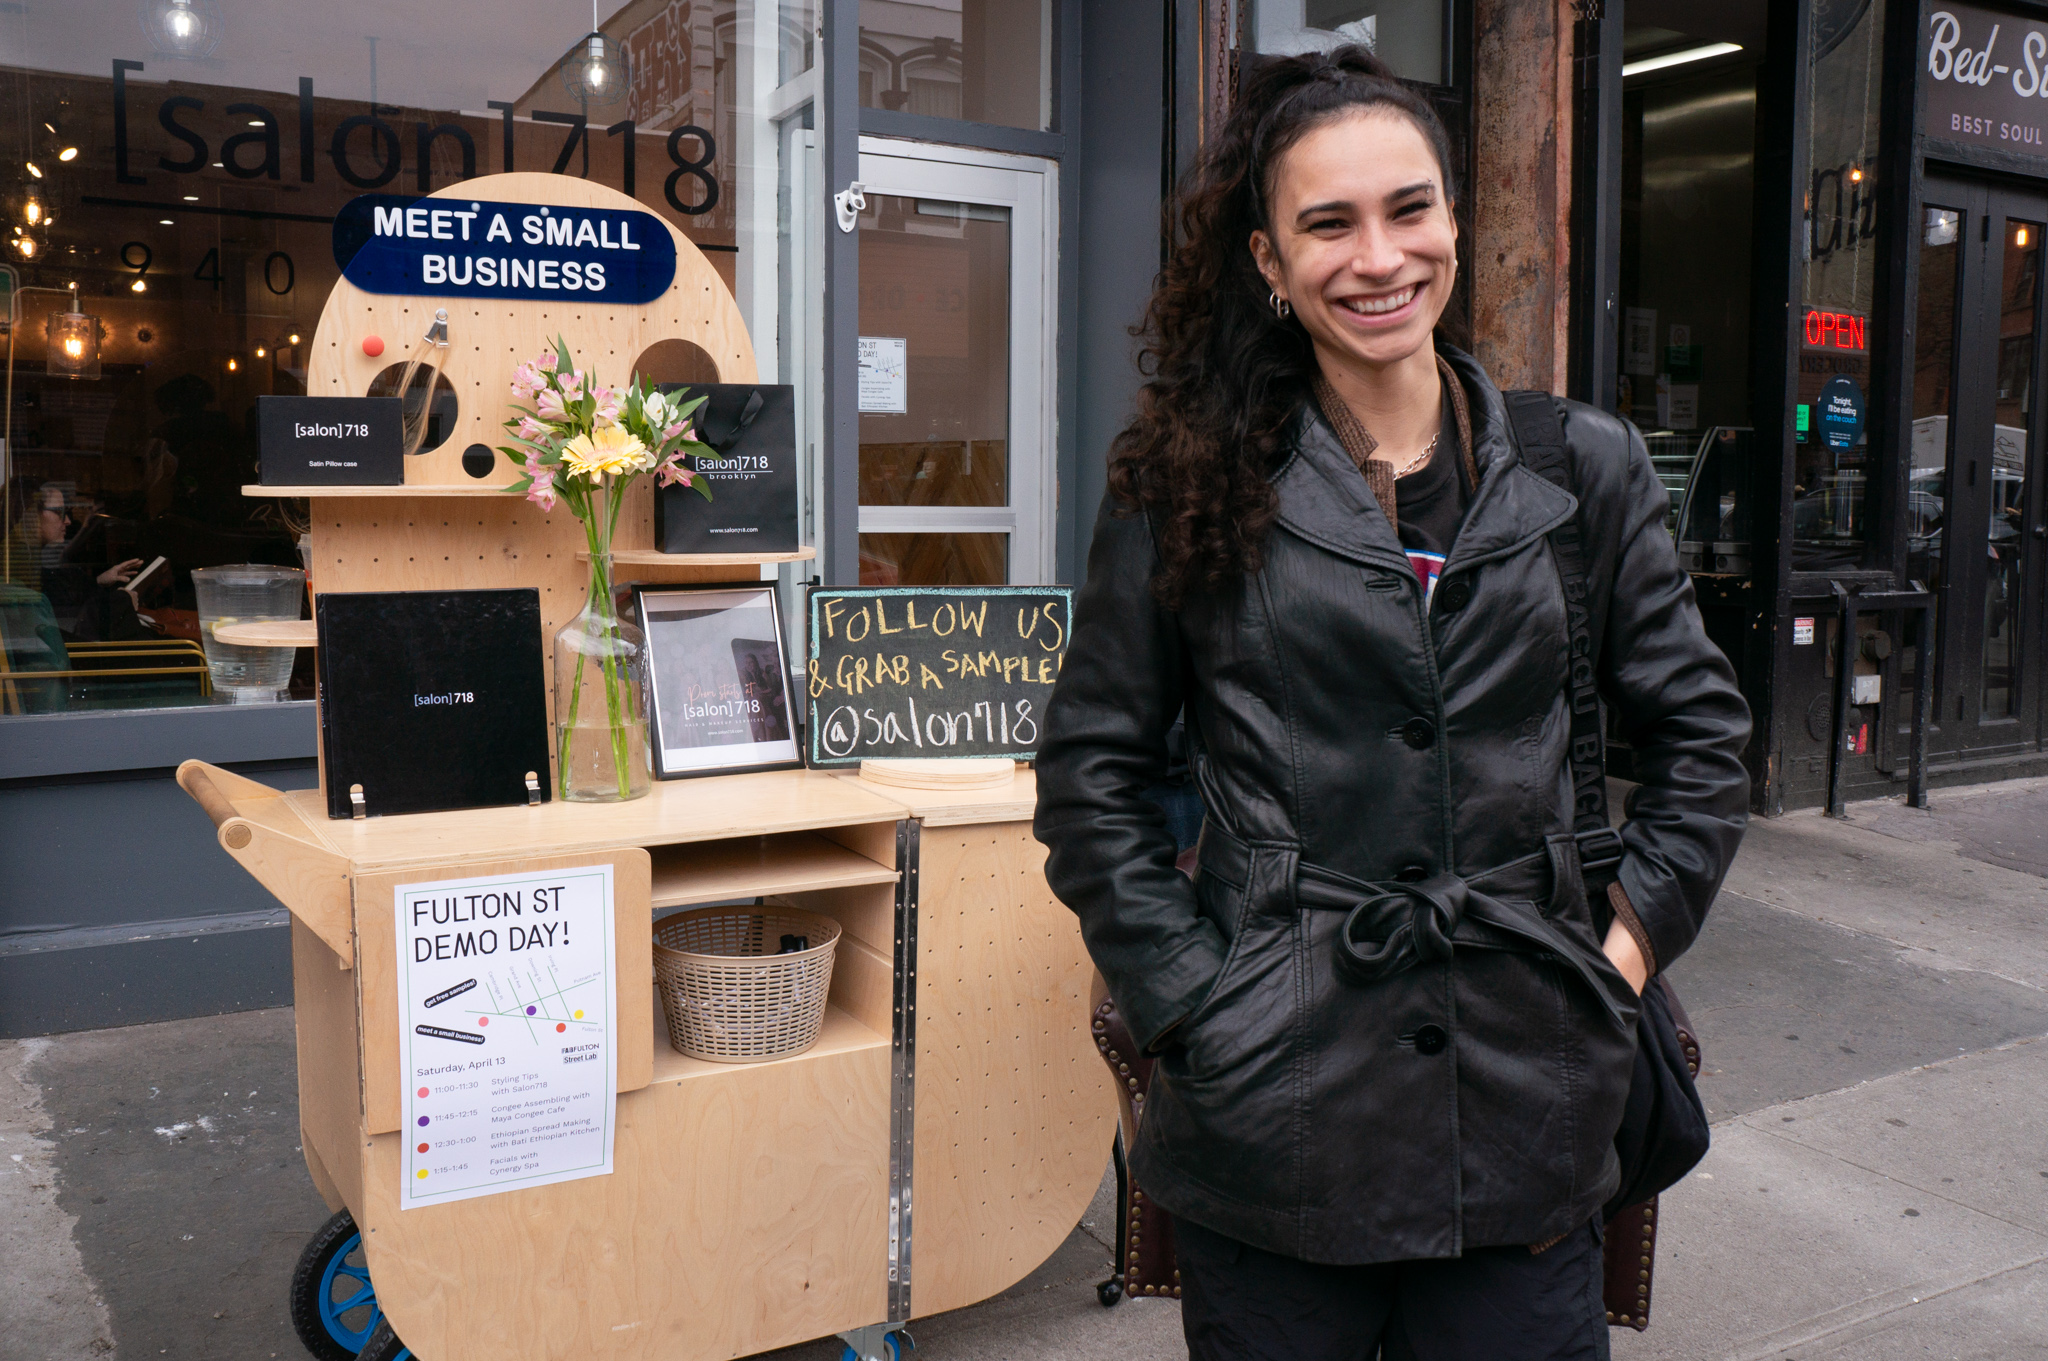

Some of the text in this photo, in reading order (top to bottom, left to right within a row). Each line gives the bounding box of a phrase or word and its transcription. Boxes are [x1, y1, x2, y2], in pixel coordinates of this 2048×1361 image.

[1951, 113, 2043, 145] BEST SOUL
[374, 206, 641, 250] MEET A SMALL
[422, 254, 606, 291] BUSINESS
[1806, 310, 1864, 350] OPEN
[824, 598, 1063, 651] FOLLOW US
[1564, 573, 1597, 714] BAGGU
[809, 659, 833, 698] &
[836, 653, 910, 695] GRAB
[920, 662, 944, 690] A
[718, 683, 740, 700] starts
[745, 682, 756, 697] at
[823, 697, 1038, 756] @salon718
[413, 886, 566, 926] FULTON ST
[414, 921, 570, 963] DEMO DAY!
[426, 980, 476, 1008] get free samples!
[417, 1026, 433, 1034] meet
[438, 1030, 456, 1038] small
[455, 1032, 484, 1042] business!
[417, 1056, 506, 1076] Saturday, April 13
[564, 1056, 584, 1064] Street
[434, 1081, 478, 1094] 11:00-11:30
[491, 1072, 539, 1086] Styling Tips
[491, 1082, 548, 1096] with Salon718
[491, 1092, 590, 1114] Congee Assembling with
[434, 1109, 478, 1122] 11:45-12:15
[491, 1105, 566, 1124] Maya Congee Cafe
[490, 1118, 591, 1140] Ethiopian Spread Making
[490, 1126, 600, 1150] with Bati Ethiopian Kitchen
[434, 1136, 476, 1148] 12:30-1:00
[434, 1163, 468, 1174] 1:15-1:45
[489, 1161, 539, 1176] Cynergy Spa
[490, 1151, 538, 1165] Facials with
